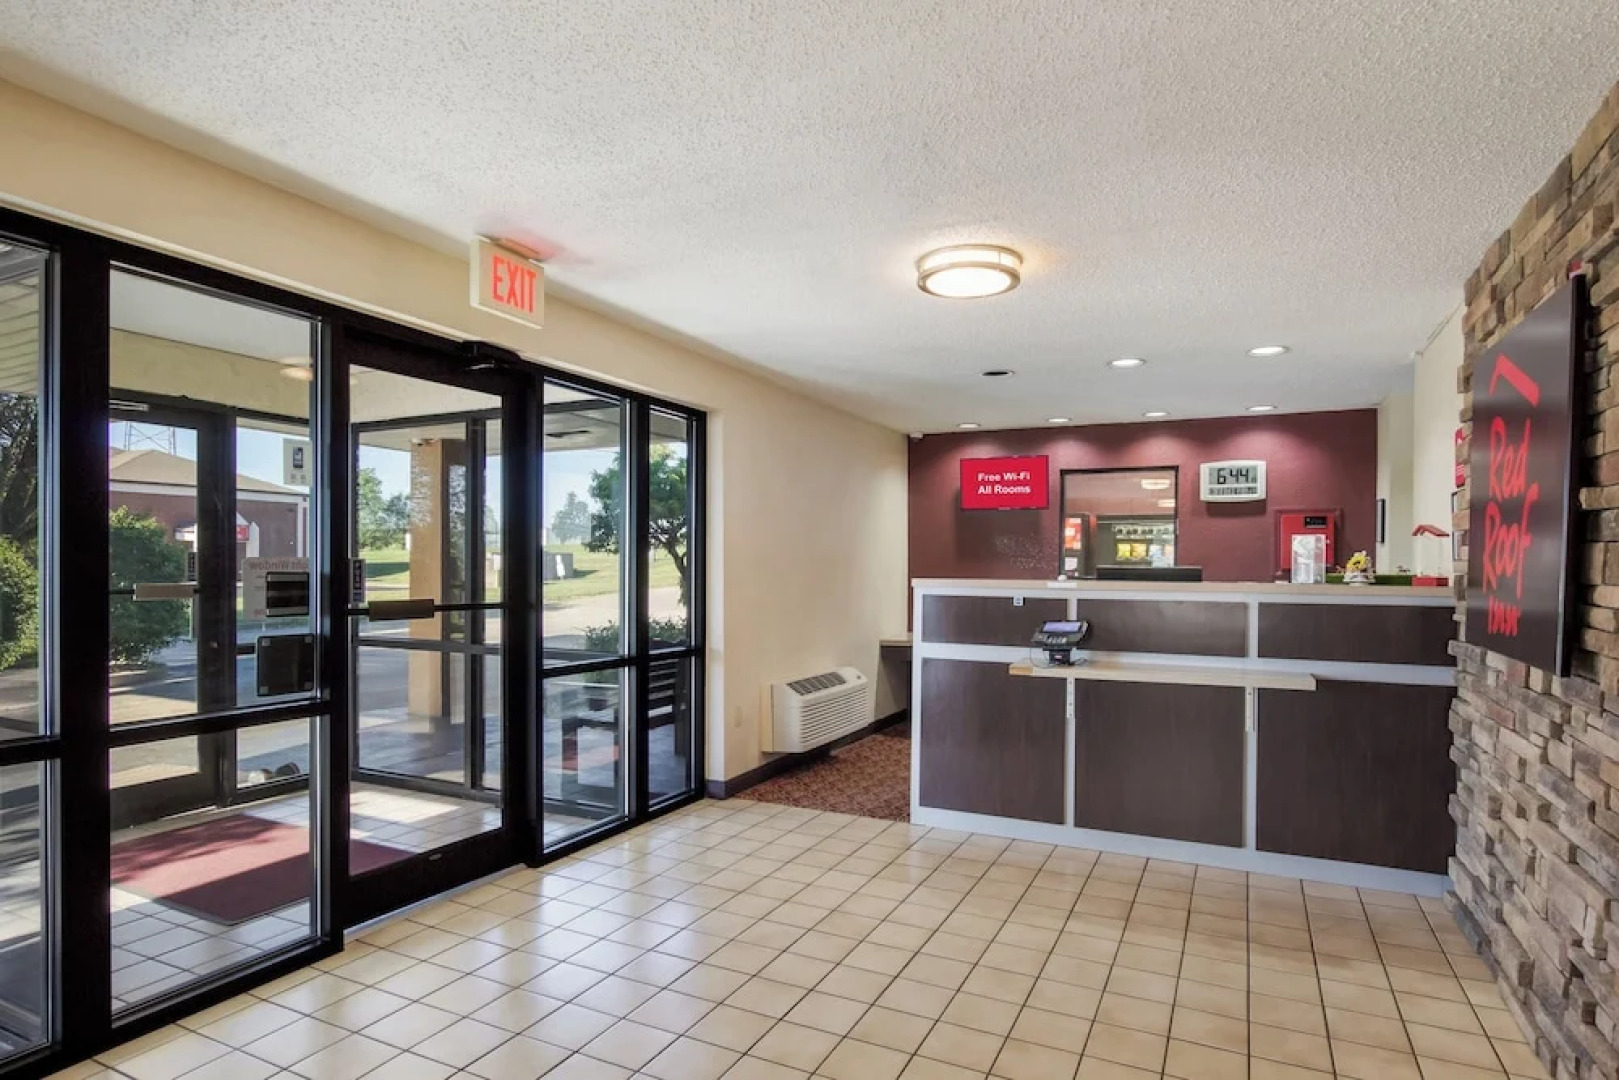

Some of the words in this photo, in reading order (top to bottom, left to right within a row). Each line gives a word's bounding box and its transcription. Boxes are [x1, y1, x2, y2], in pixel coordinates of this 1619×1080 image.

[492, 255, 537, 314] EXIT
[977, 472, 1001, 482] Free
[1003, 471, 1031, 481] Wi-Fi
[1488, 415, 1531, 503] Red
[977, 485, 993, 495] All
[994, 484, 1032, 495] Rooms
[1482, 482, 1540, 599] Roof
